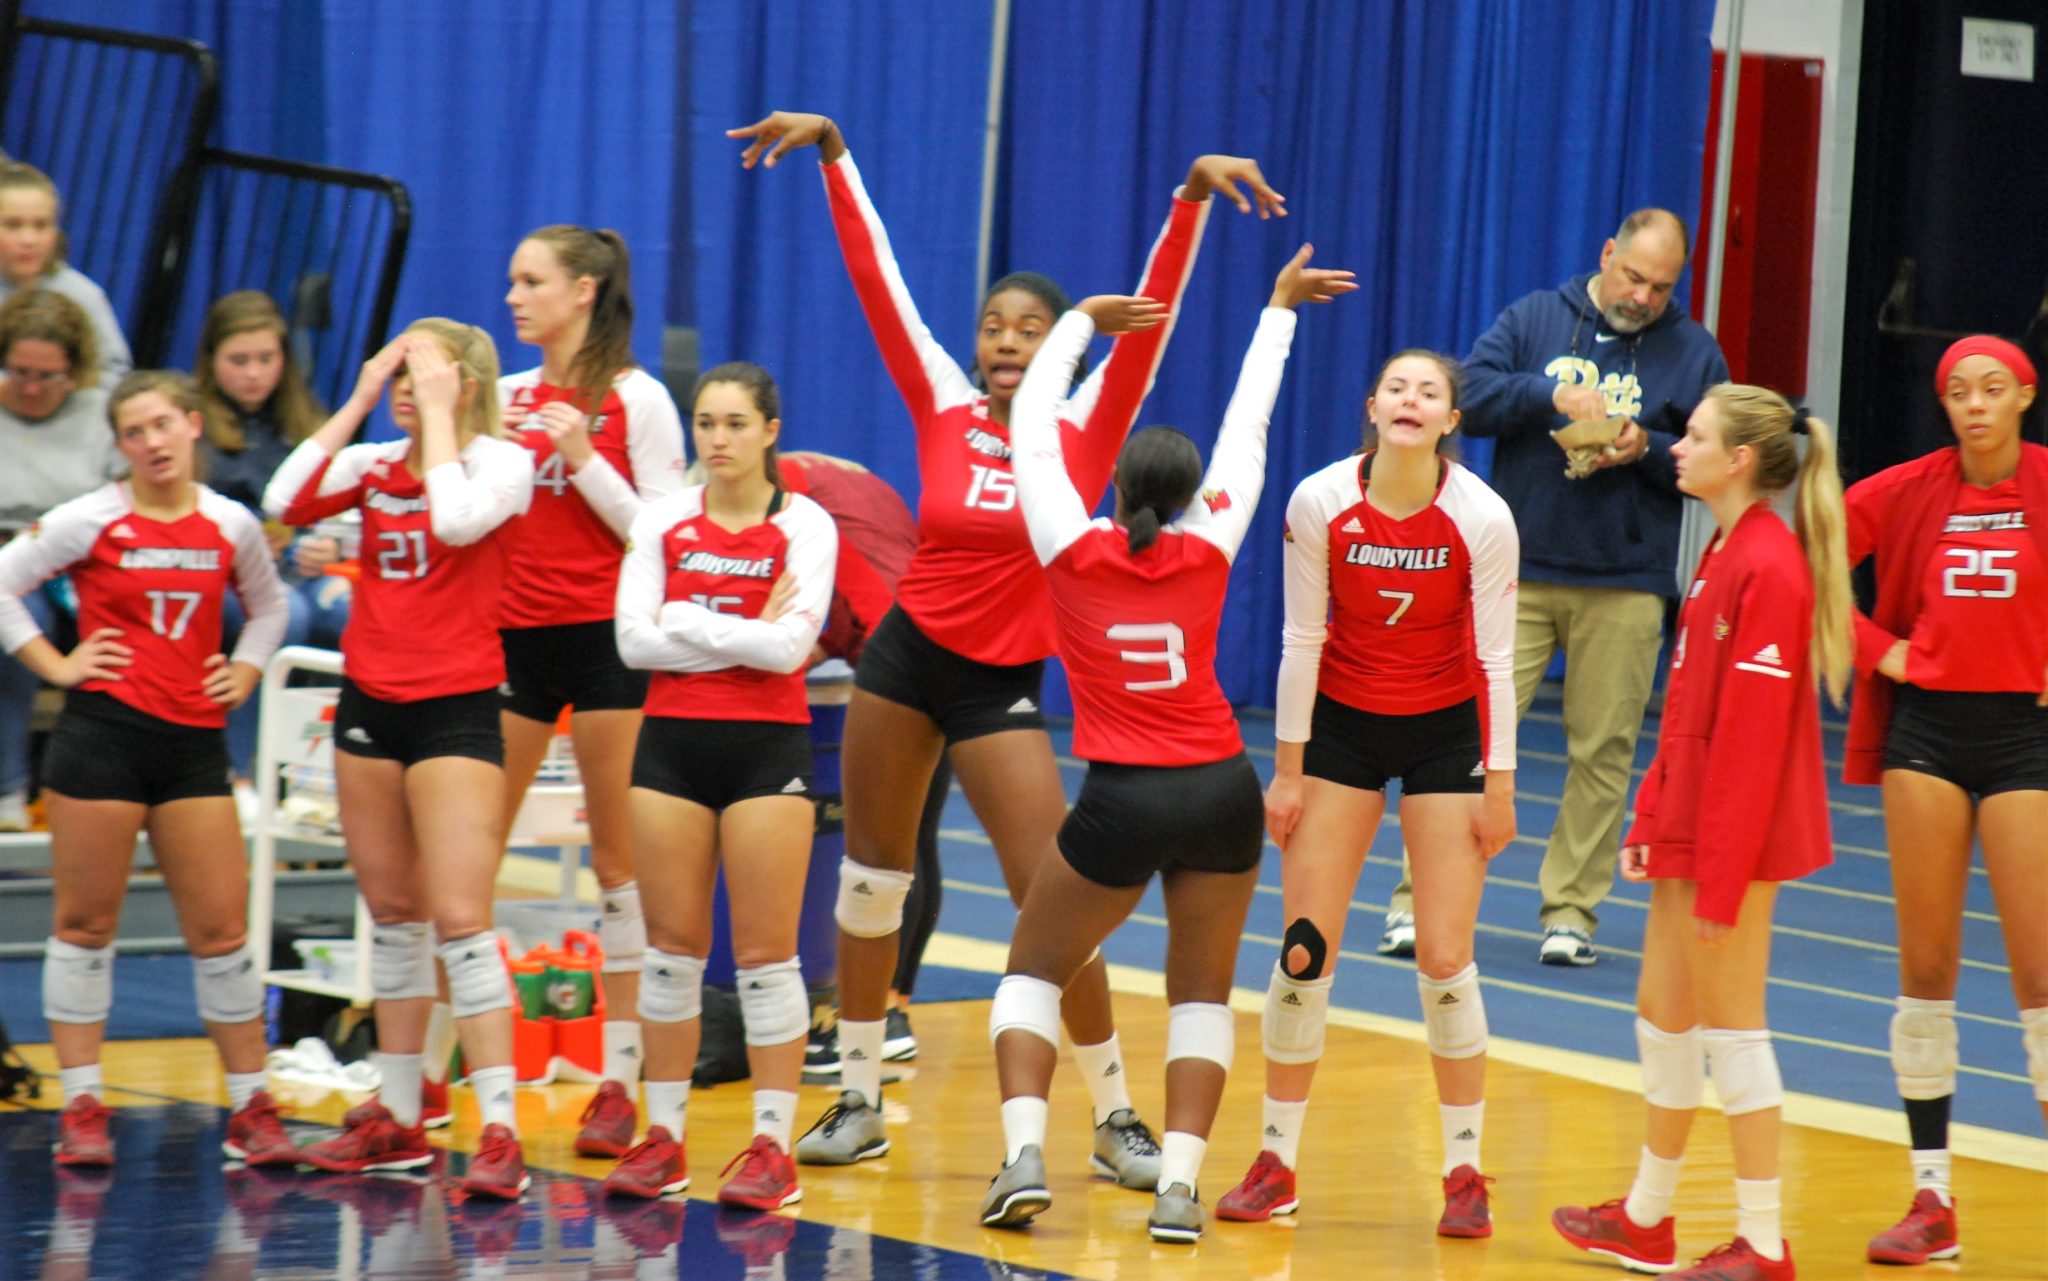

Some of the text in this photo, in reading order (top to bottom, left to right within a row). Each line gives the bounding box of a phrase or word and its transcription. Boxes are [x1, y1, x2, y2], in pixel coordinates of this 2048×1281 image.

[1544, 356, 1643, 418] Ptt
[965, 464, 1017, 512] 15
[377, 530, 428, 579] 21
[676, 551, 775, 579] LOUISVILLE
[1344, 542, 1450, 571] LOUISVILLE
[1943, 548, 2019, 599] 25
[145, 590, 204, 641] 17
[1376, 589, 1415, 626] 7
[1105, 622, 1189, 692] 3
